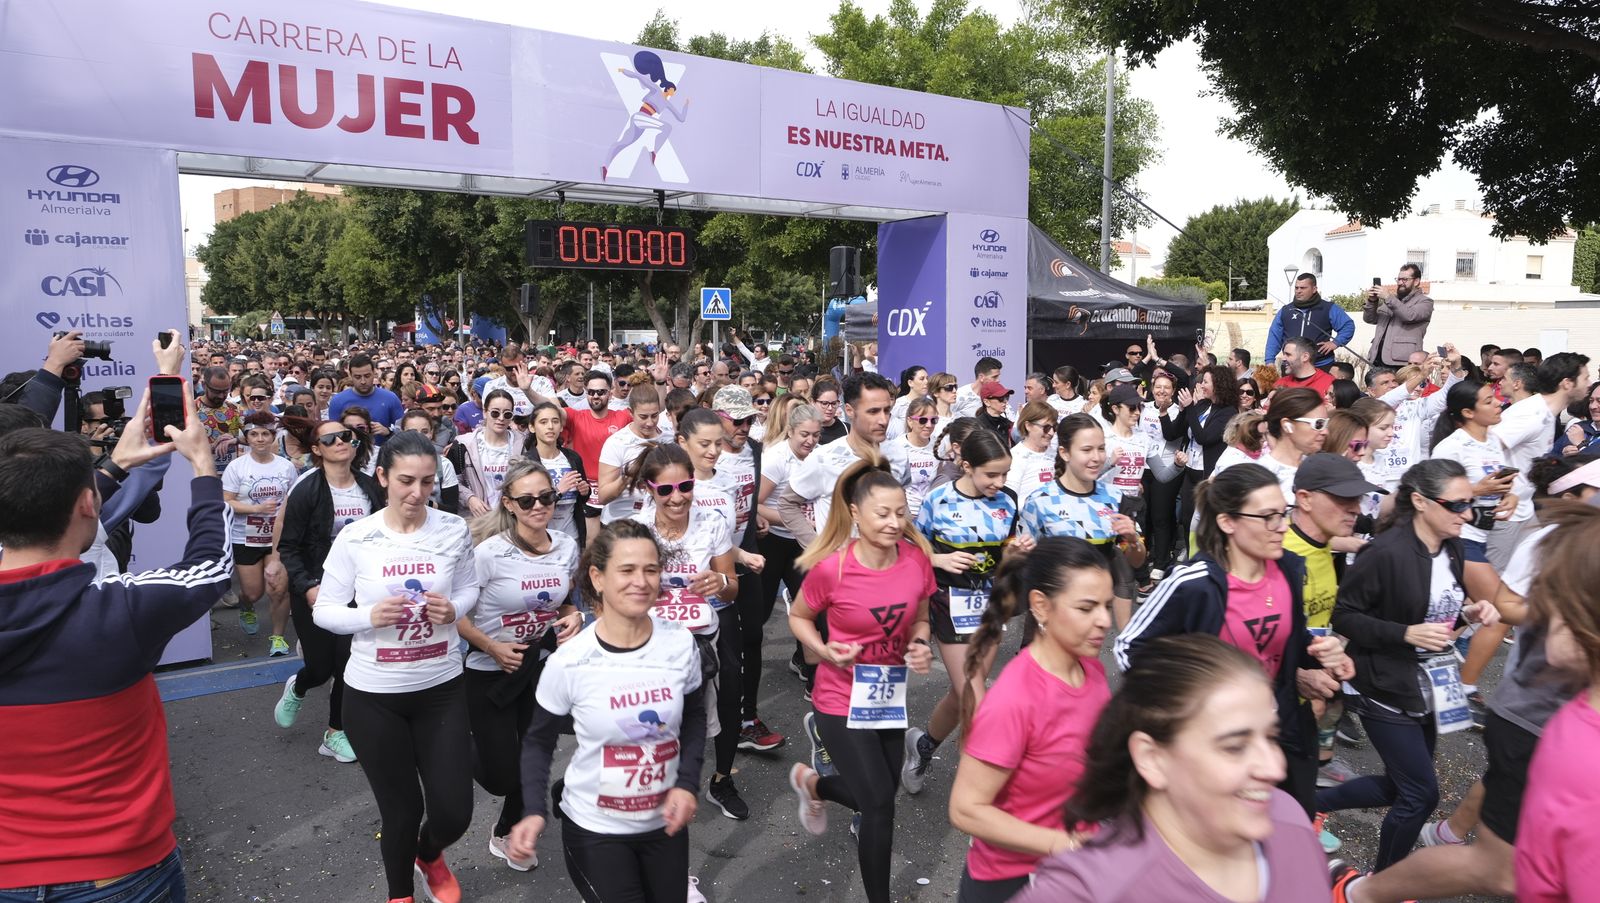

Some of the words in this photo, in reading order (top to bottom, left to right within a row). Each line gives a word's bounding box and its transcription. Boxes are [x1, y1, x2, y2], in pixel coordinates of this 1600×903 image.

[207, 12, 368, 58] CARRERA
[378, 36, 417, 64] DE
[428, 43, 463, 71] LA
[191, 52, 480, 145] MUJER
[816, 98, 838, 118] LA
[842, 102, 925, 130] IGUALDAD
[787, 126, 811, 145] ES
[815, 129, 897, 157] NUESTRA
[900, 140, 949, 162] META.
[855, 166, 885, 177] ALMERÍA
[27, 189, 120, 204] HYUNDAI
[41, 203, 111, 216] Almerialva
[55, 232, 129, 248] cajamar
[560, 226, 685, 266] 00:00:00
[972, 244, 1007, 252] HYUNDAI
[981, 269, 1008, 279] cajamar
[41, 275, 106, 297] CASI
[974, 295, 998, 308] CASI
[67, 313, 133, 328] vithas
[981, 317, 1006, 328] vithas
[976, 347, 1005, 357] aqualia
[82, 362, 136, 380] ualia
[1388, 457, 1407, 466] 369
[735, 474, 753, 482] UJER
[1120, 466, 1142, 475] 2527
[696, 498, 727, 507] MUJER
[382, 563, 436, 577] MUJER
[664, 564, 698, 574] UJER
[521, 578, 561, 590] MUJER
[655, 605, 701, 620] 2526
[395, 622, 434, 641] 723
[514, 622, 546, 639] 992
[609, 687, 673, 709] MUJER
[867, 683, 895, 700] 215
[624, 762, 666, 788] 764
